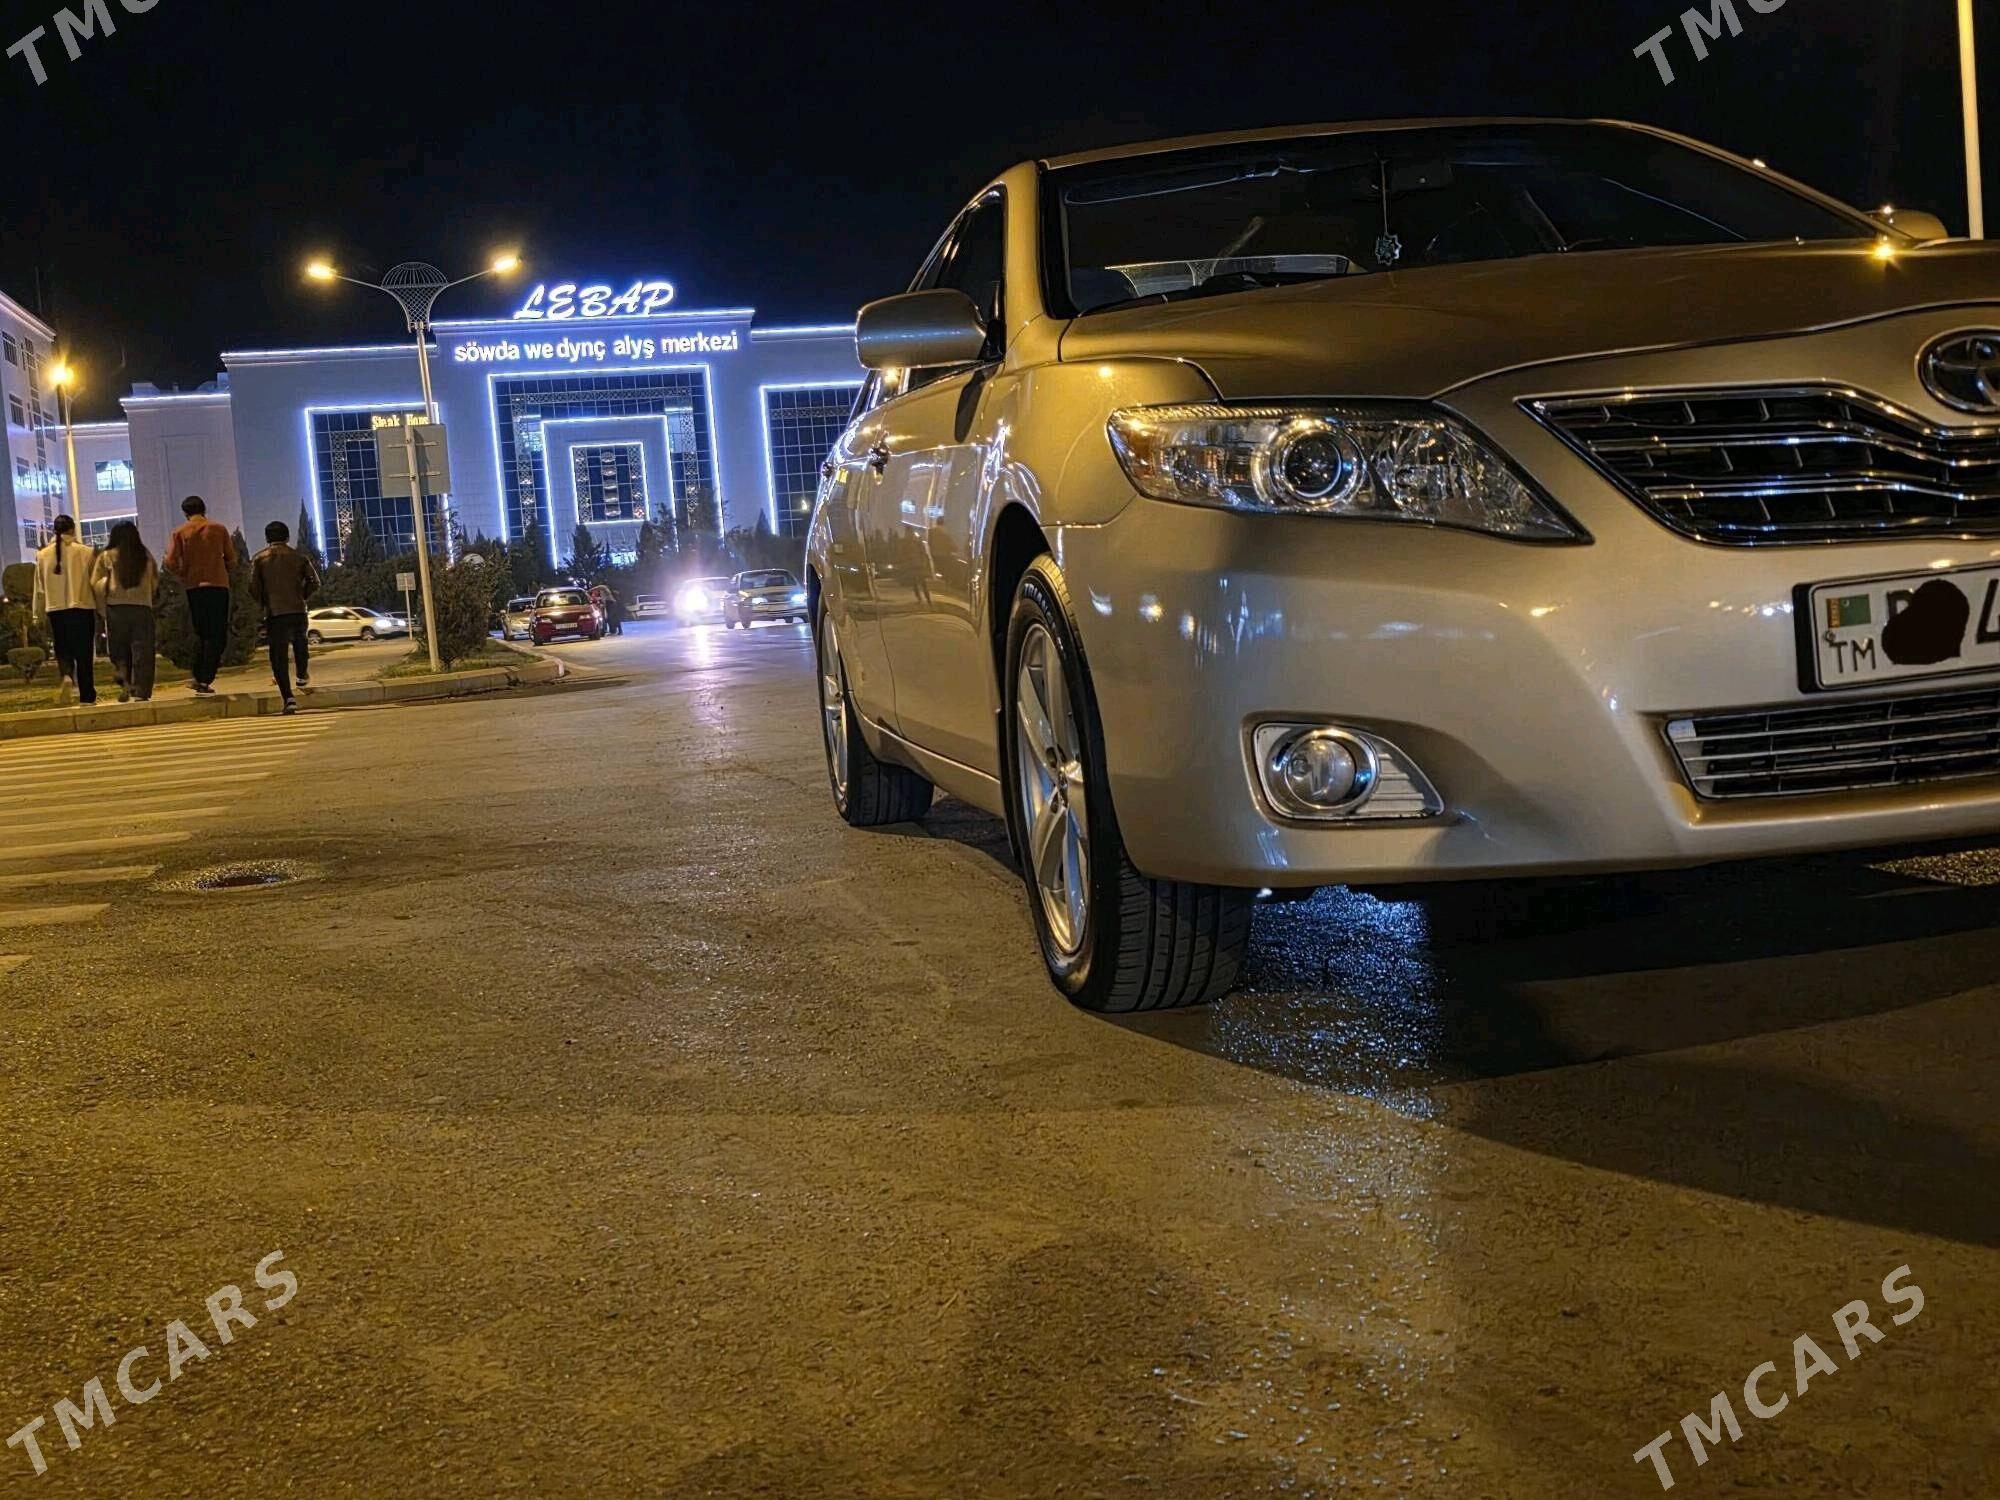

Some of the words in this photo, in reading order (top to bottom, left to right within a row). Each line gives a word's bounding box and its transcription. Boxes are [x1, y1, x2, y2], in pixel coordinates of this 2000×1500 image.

[513, 281, 675, 320] LEBAP
[454, 340, 520, 362] söwda
[523, 342, 554, 360] we
[556, 337, 606, 363] dynç
[613, 334, 656, 360] alyş
[661, 329, 738, 354] merkezi
[405, 413, 430, 426] Hous
[1829, 637, 1876, 674] TM
